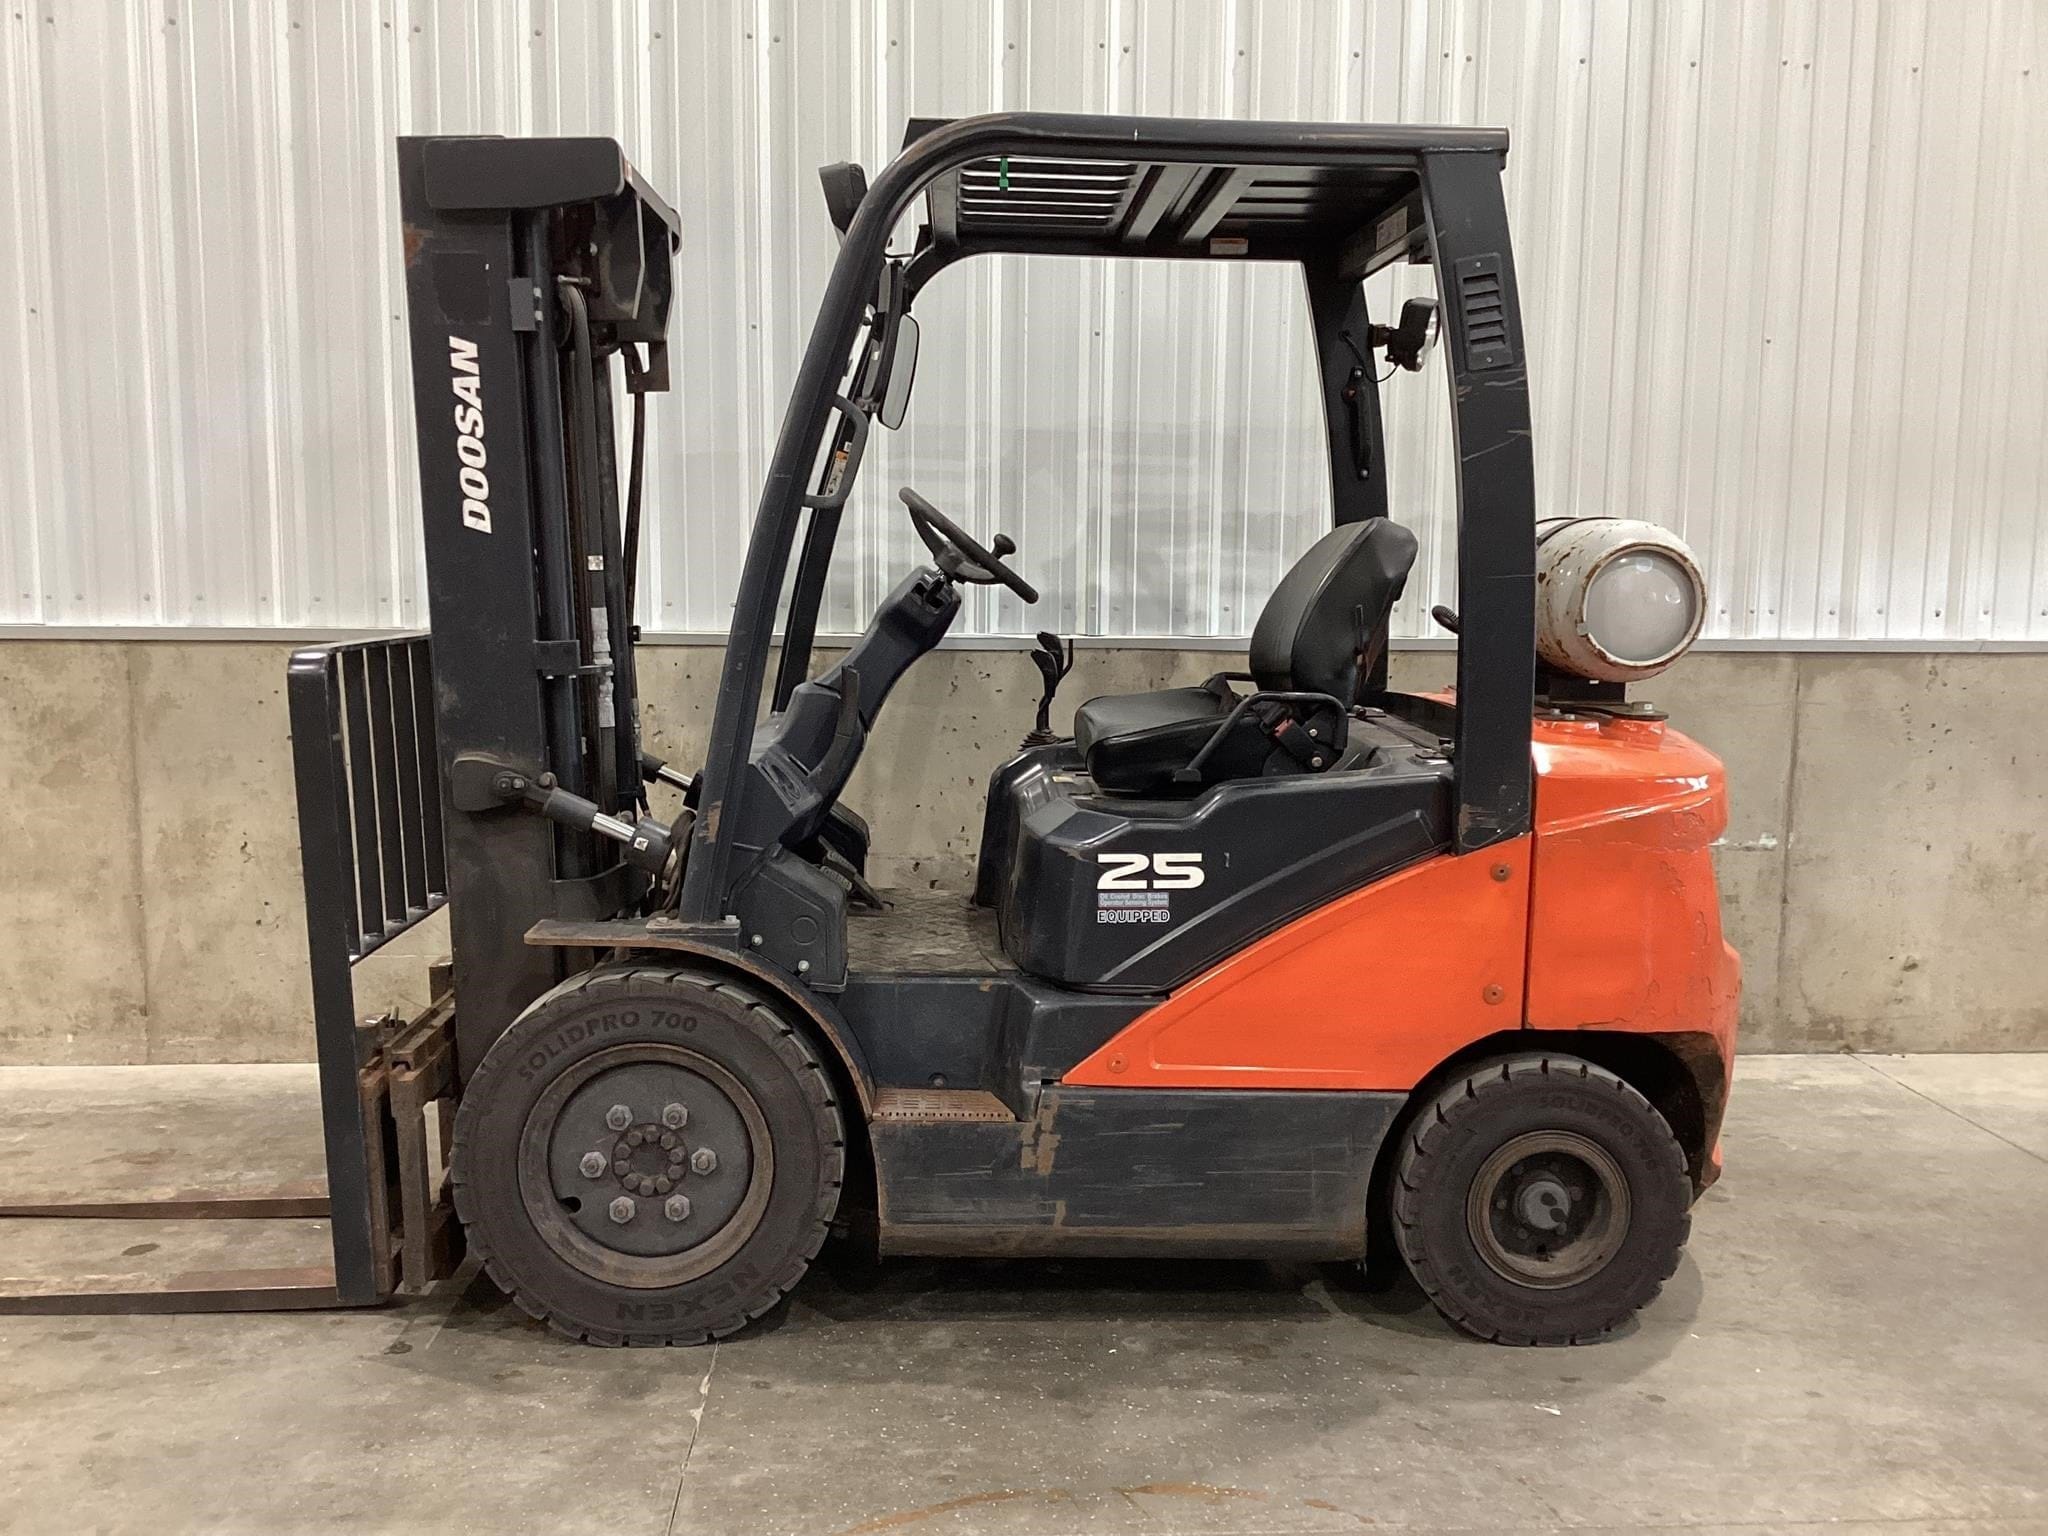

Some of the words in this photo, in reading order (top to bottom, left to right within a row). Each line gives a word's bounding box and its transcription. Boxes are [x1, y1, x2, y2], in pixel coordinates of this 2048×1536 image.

[448, 334, 493, 535] DOOSAN
[1097, 852, 1206, 890] 25
[1097, 909, 1171, 924] EQUIPPED
[516, 1010, 640, 1082] SOLIDPRO
[650, 1010, 699, 1034] 700
